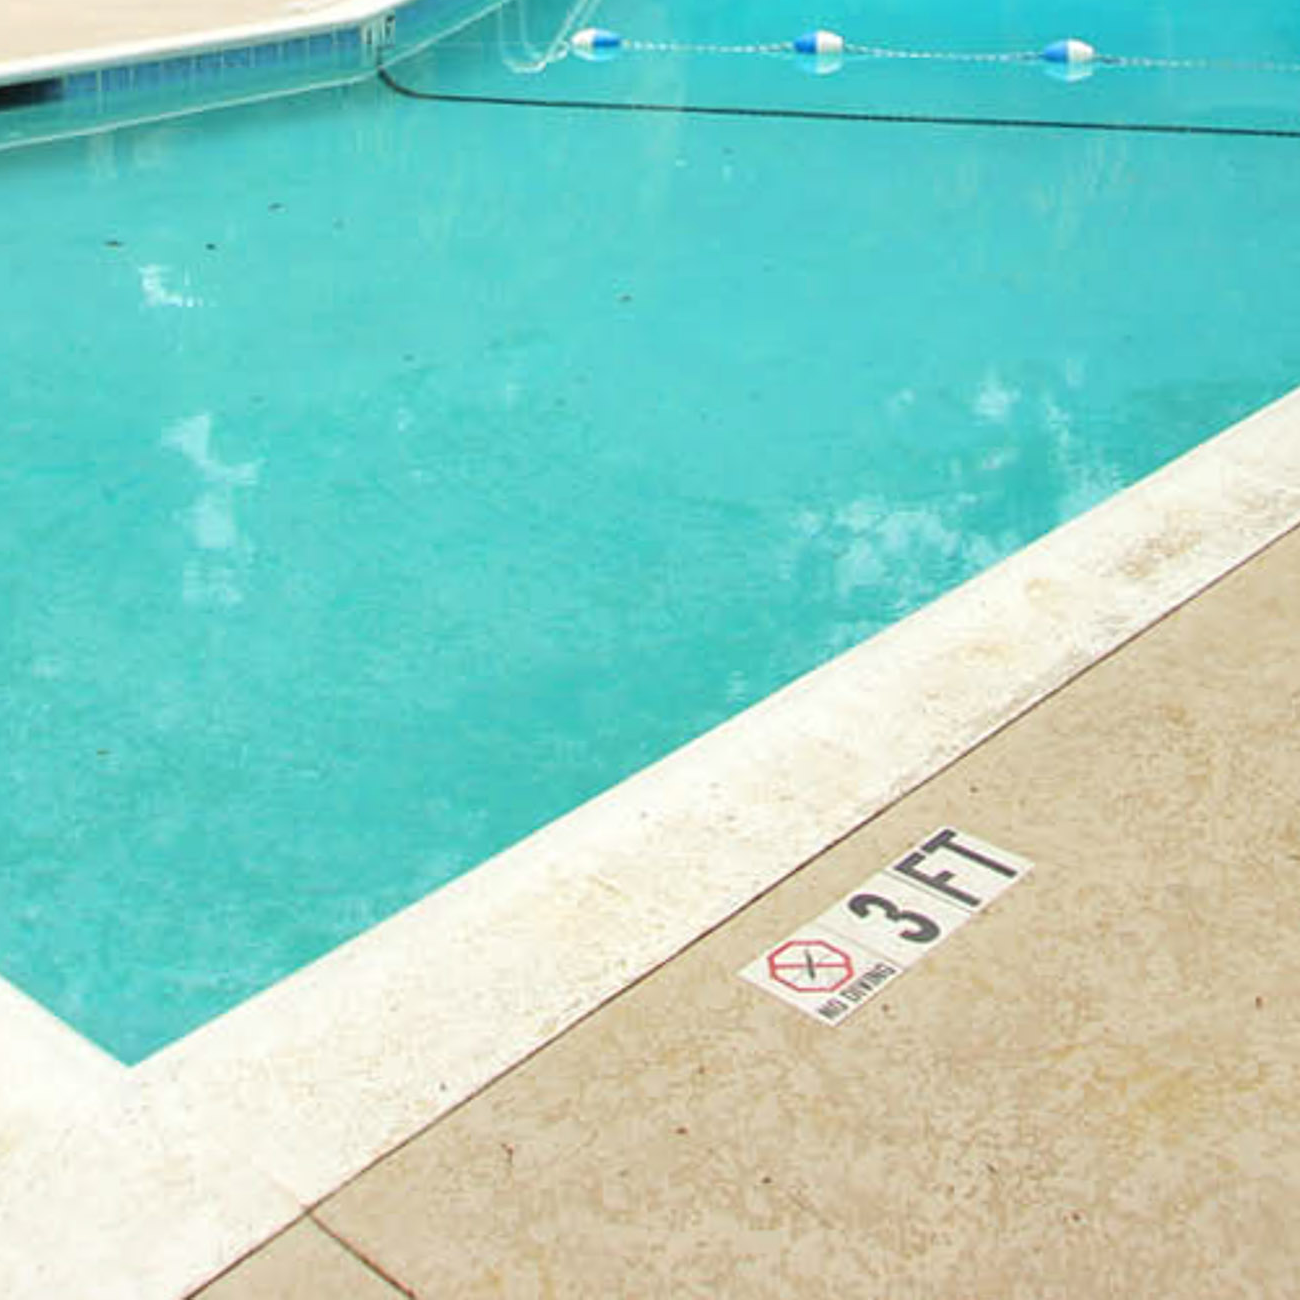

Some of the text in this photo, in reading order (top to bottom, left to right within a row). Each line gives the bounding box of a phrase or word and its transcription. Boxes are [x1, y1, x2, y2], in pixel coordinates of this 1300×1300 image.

[847, 828, 1018, 944] 3 FT
[817, 962, 897, 1020] NO DIVING
